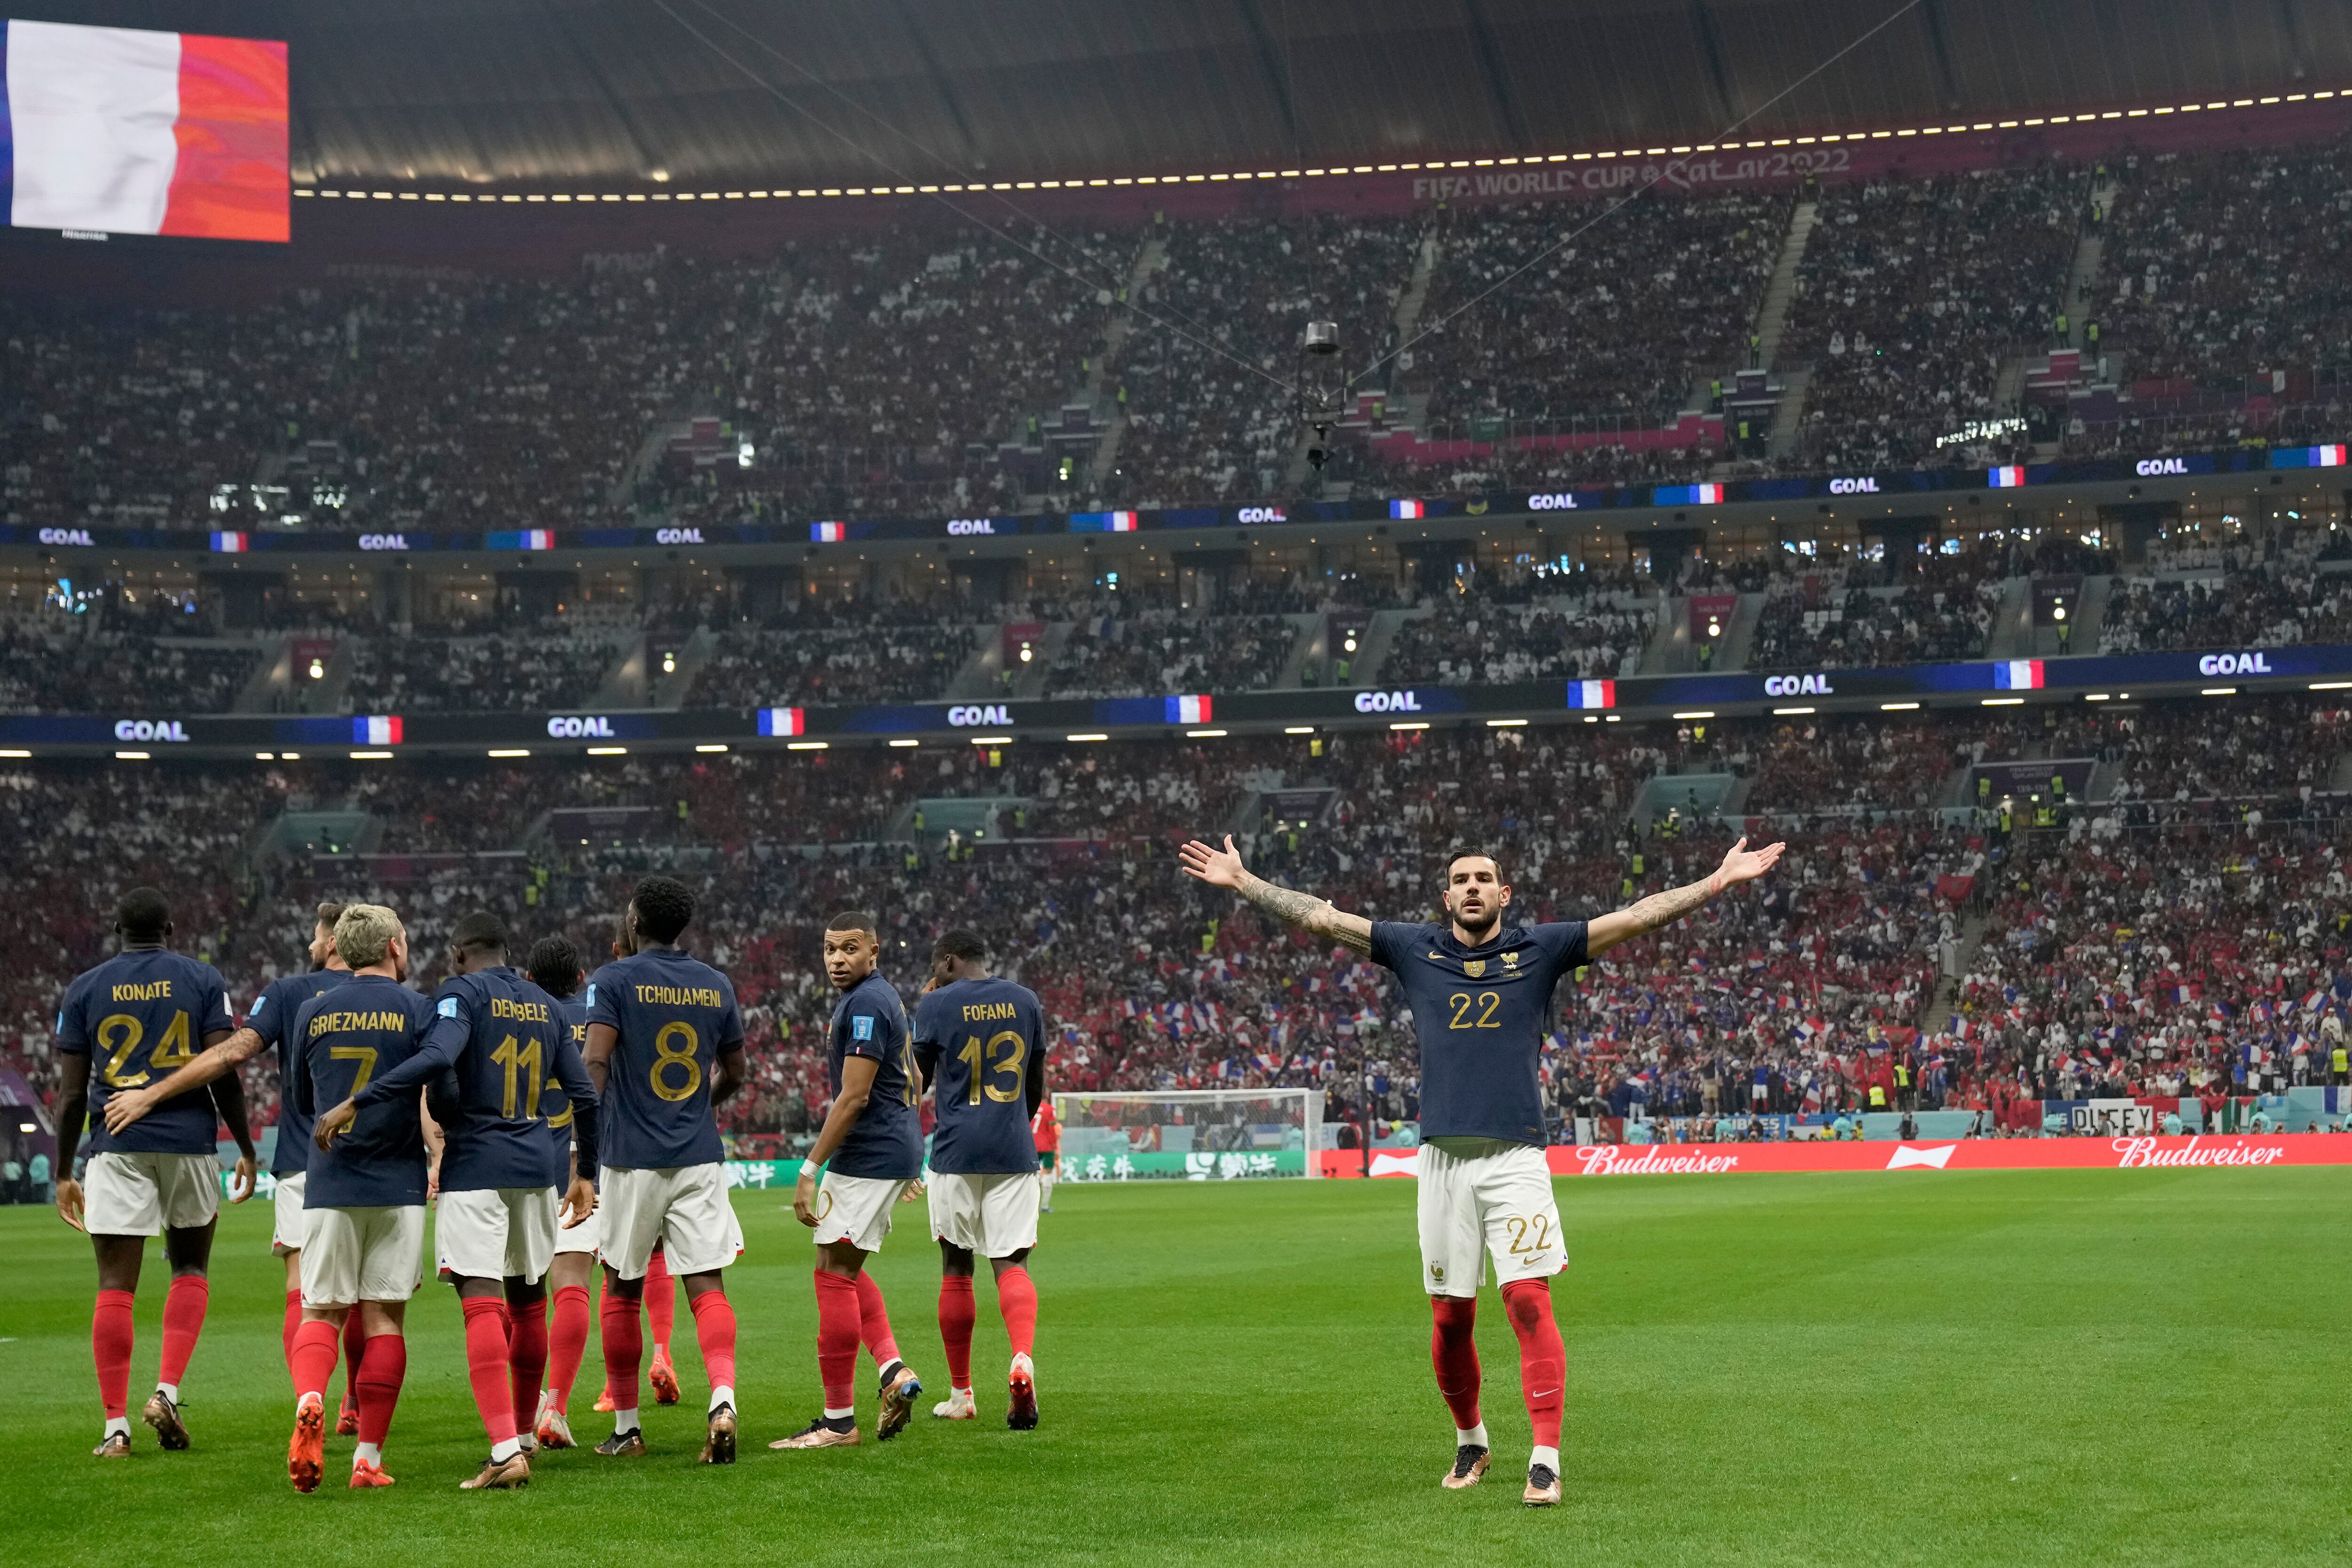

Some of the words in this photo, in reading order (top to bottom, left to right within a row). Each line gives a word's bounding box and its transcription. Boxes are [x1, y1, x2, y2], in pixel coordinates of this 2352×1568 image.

[1413, 176, 1470, 200] FIFA
[1474, 170, 1576, 197] WORLD
[1581, 166, 1636, 191] CUP
[2136, 457, 2188, 476] GOAL
[1829, 477, 1880, 494] GOAL
[1528, 493, 1577, 510] GOAL
[1238, 507, 1287, 523] GOAL
[39, 528, 95, 546] GOAL
[656, 528, 704, 544] GOAL
[947, 518, 995, 535] GOAL
[358, 534, 409, 550] GOAL
[2199, 652, 2272, 676] GOAL
[1764, 674, 1834, 696] GOAL
[1354, 691, 1422, 713] GOAL
[947, 705, 1014, 726] GOAL
[114, 719, 190, 741] GOAL
[547, 716, 615, 738] GOAL
[112, 980, 172, 1002] KONATE
[635, 985, 722, 1008] TCHOUAMENI
[962, 1003, 1017, 1022] FOFANA
[1449, 991, 1502, 1030] 22
[309, 1011, 405, 1038] GRIEZMANN
[97, 1009, 199, 1087] 24
[650, 1021, 701, 1102] 8
[957, 1030, 1026, 1106] 13
[489, 1034, 542, 1121] 11
[329, 1046, 378, 1134] 7
[1575, 1144, 1739, 1175] Budweiser
[2111, 1135, 2283, 1168] Budweiser
[1507, 1214, 1552, 1254] 22
